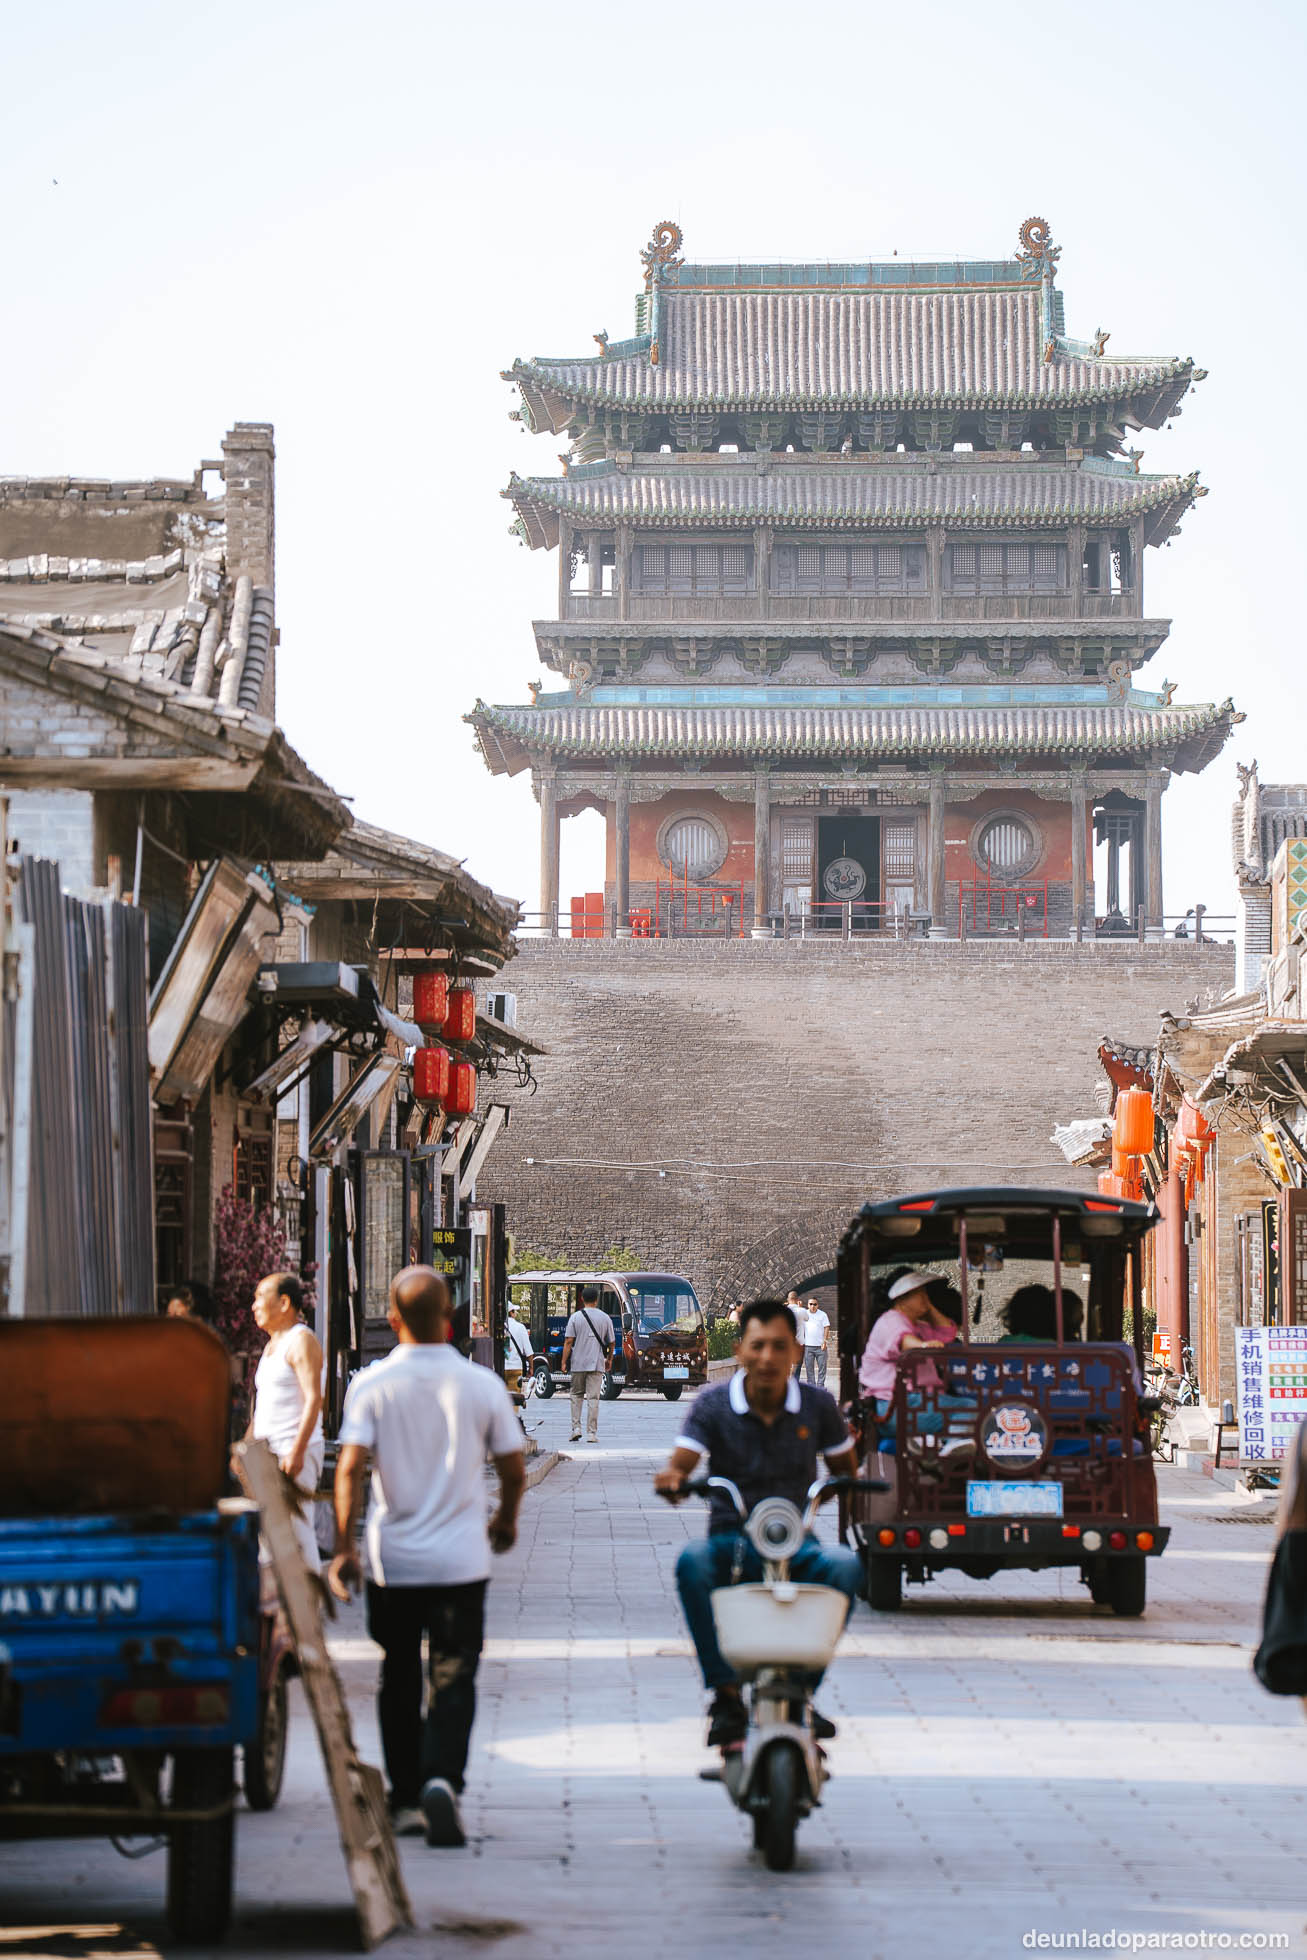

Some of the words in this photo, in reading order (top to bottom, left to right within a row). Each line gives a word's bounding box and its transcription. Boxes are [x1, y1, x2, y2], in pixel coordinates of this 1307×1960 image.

[433, 1231, 455, 1244] 服饰
[433, 1261, 455, 1274] 元起
[1240, 1328, 1265, 1460] 手机销售维修回收
